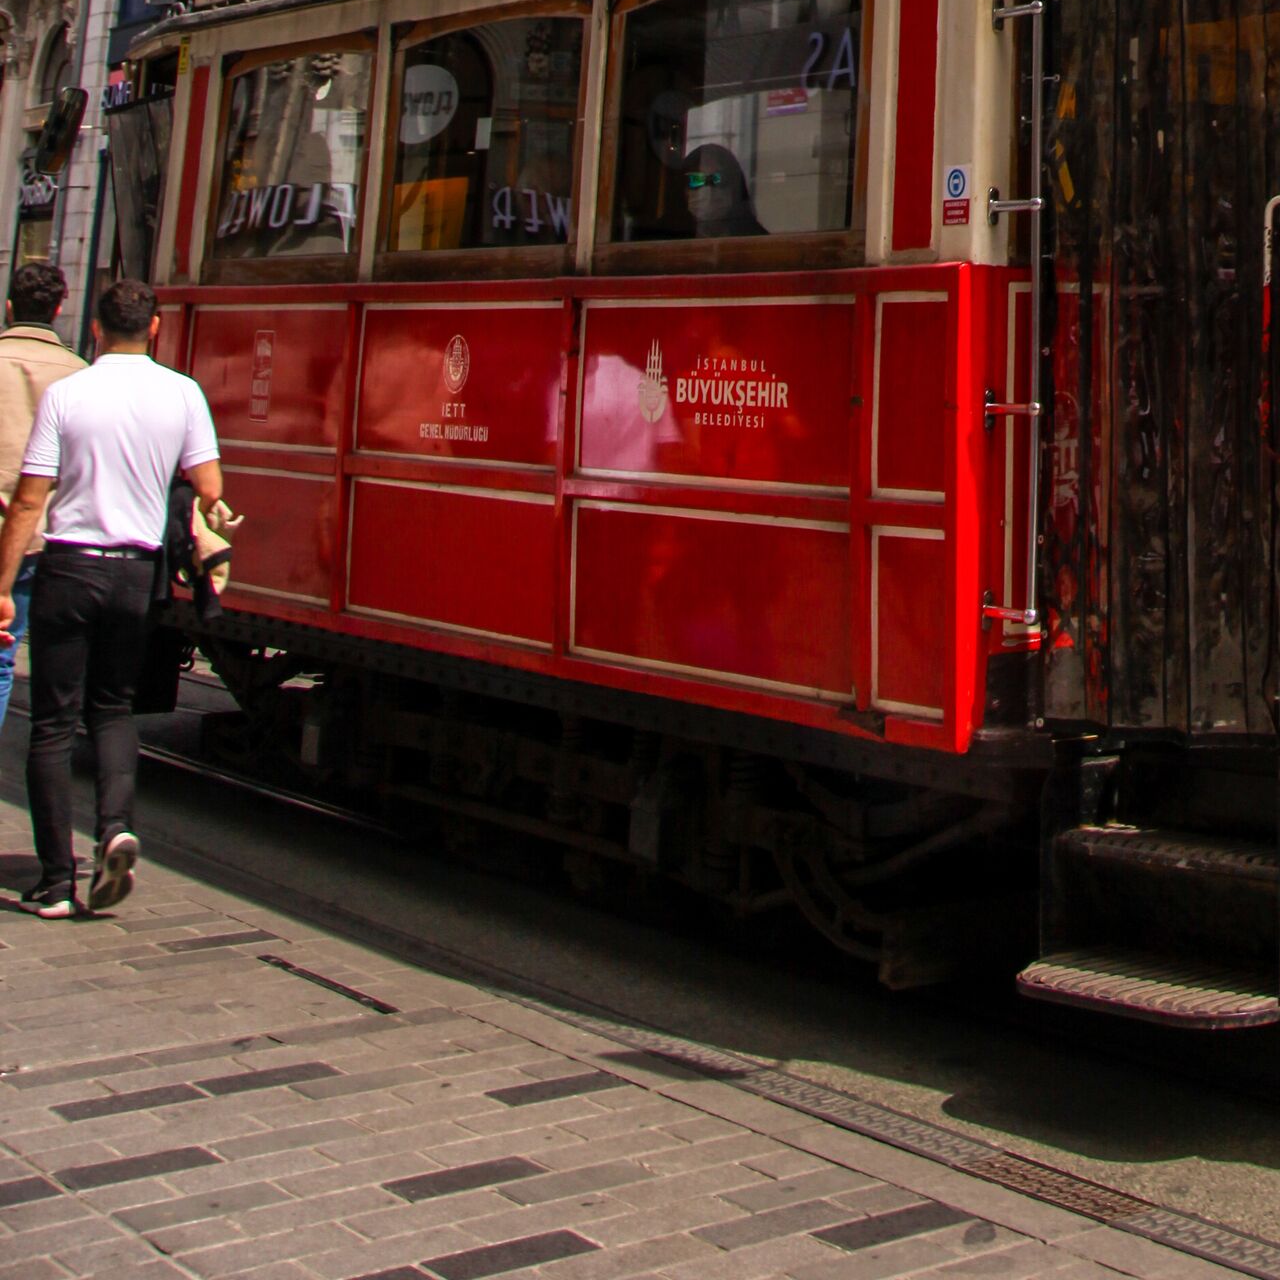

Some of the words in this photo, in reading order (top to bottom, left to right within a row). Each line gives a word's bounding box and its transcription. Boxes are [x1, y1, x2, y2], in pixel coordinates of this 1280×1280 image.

[696, 354, 766, 372] İSTANBUL
[676, 370, 789, 414] BÜYÜKŞEHİR
[694, 412, 765, 429] BELEDİYESİ
[419, 423, 444, 439] GENEL
